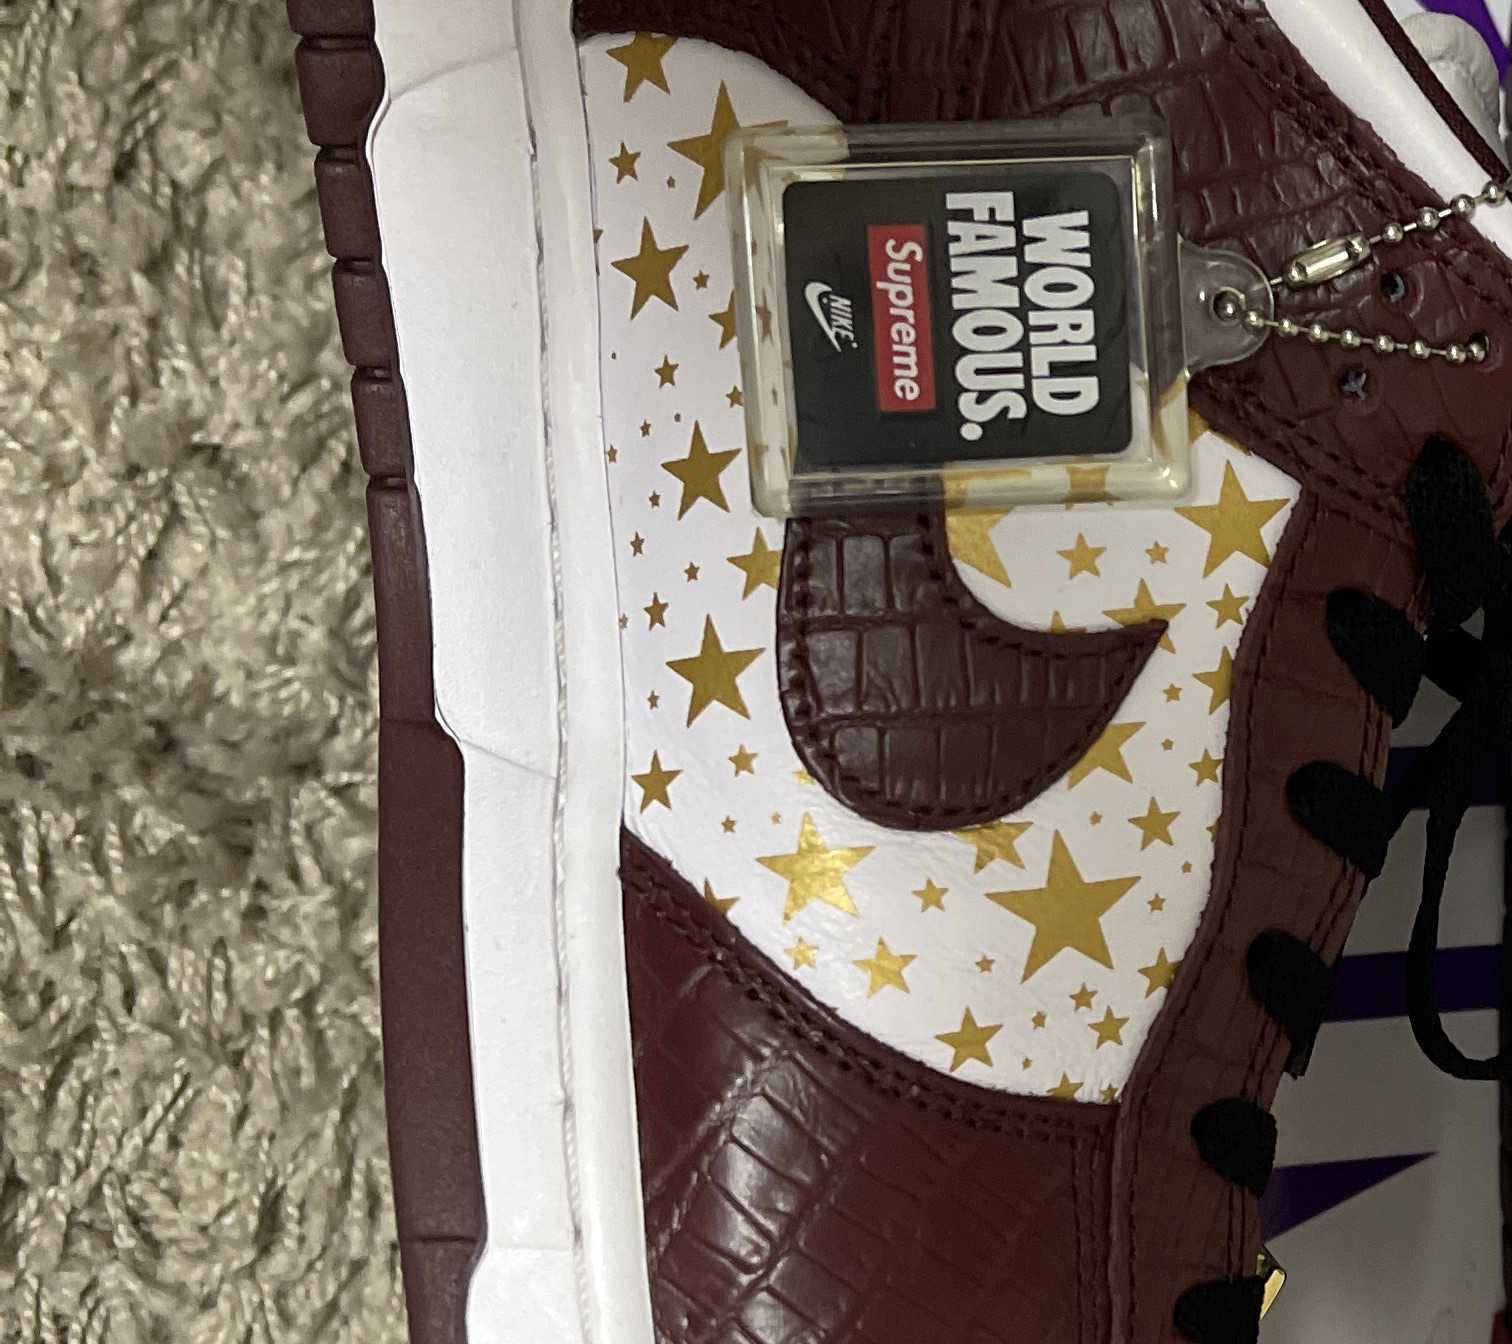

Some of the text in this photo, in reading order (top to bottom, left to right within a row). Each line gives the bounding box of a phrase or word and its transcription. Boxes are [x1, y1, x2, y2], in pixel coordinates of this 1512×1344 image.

[826, 292, 854, 344] NIKE
[875, 237, 923, 402] Supreme
[945, 190, 1028, 442] FAMOUS.
[1022, 210, 1100, 416] WORLD
